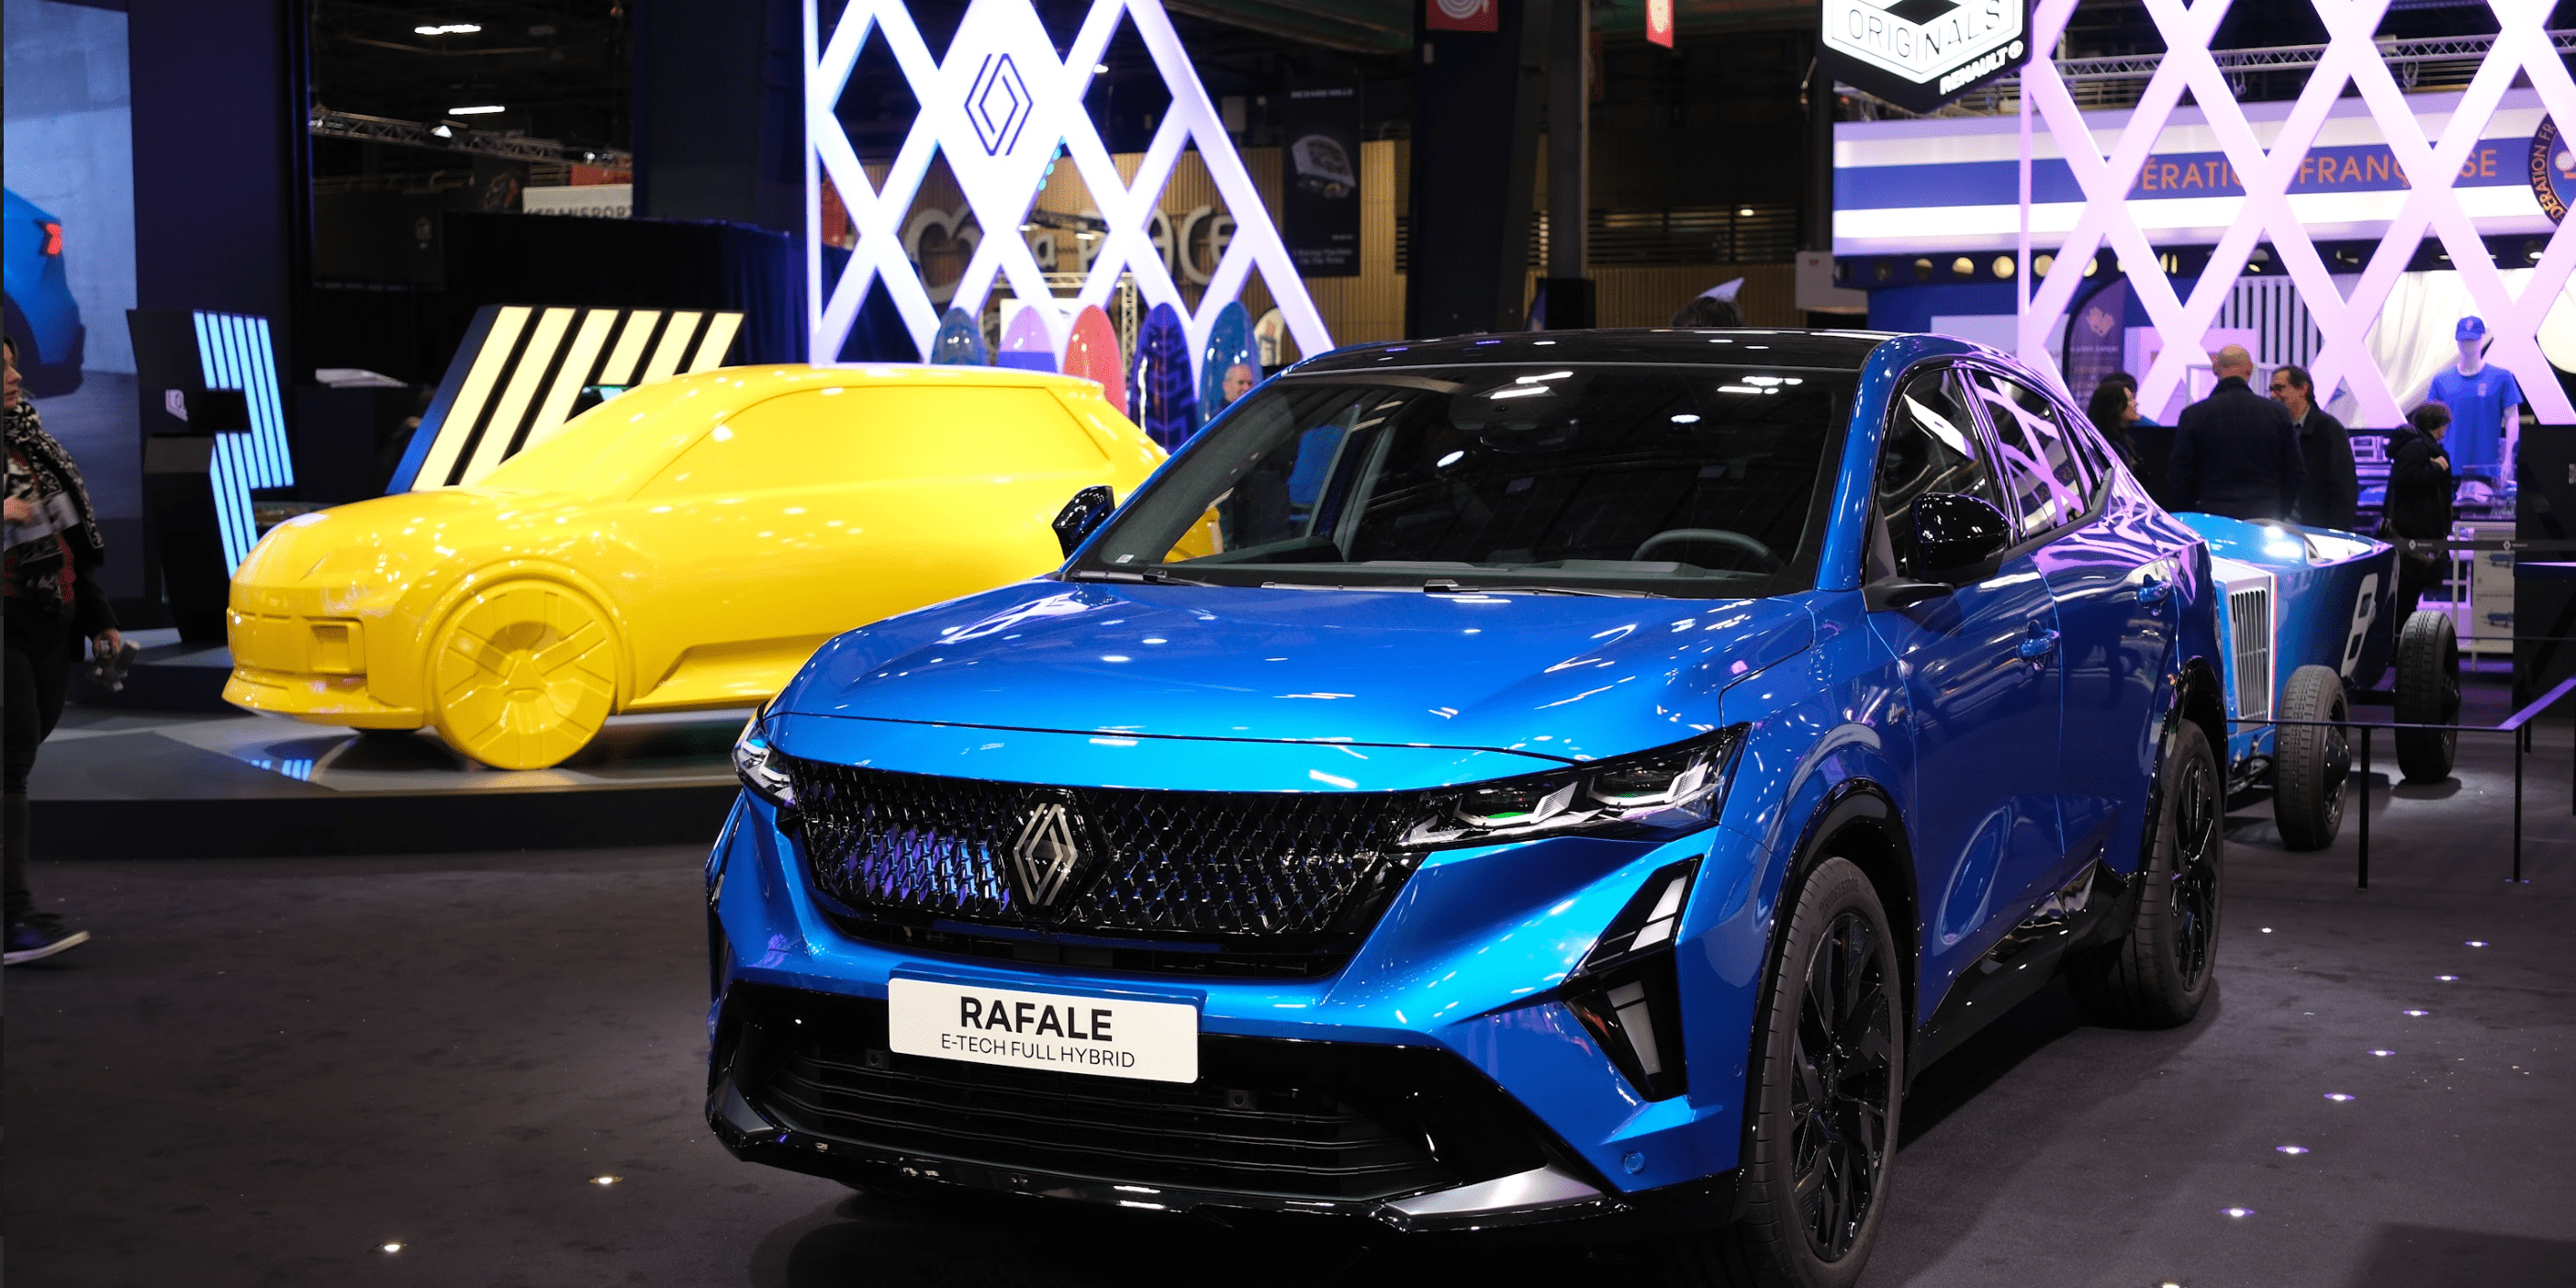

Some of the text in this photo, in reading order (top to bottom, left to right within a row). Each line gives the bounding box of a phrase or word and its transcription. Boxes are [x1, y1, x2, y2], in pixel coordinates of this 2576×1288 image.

[1848, 0, 2000, 62] ORIGINALS
[2134, 149, 2497, 191] ÉRATI FRANÇSE
[2340, 572, 2379, 678] 8
[960, 996, 1114, 1042] RAFALE
[941, 1033, 1136, 1068] E-TECH FULL HYBRID
